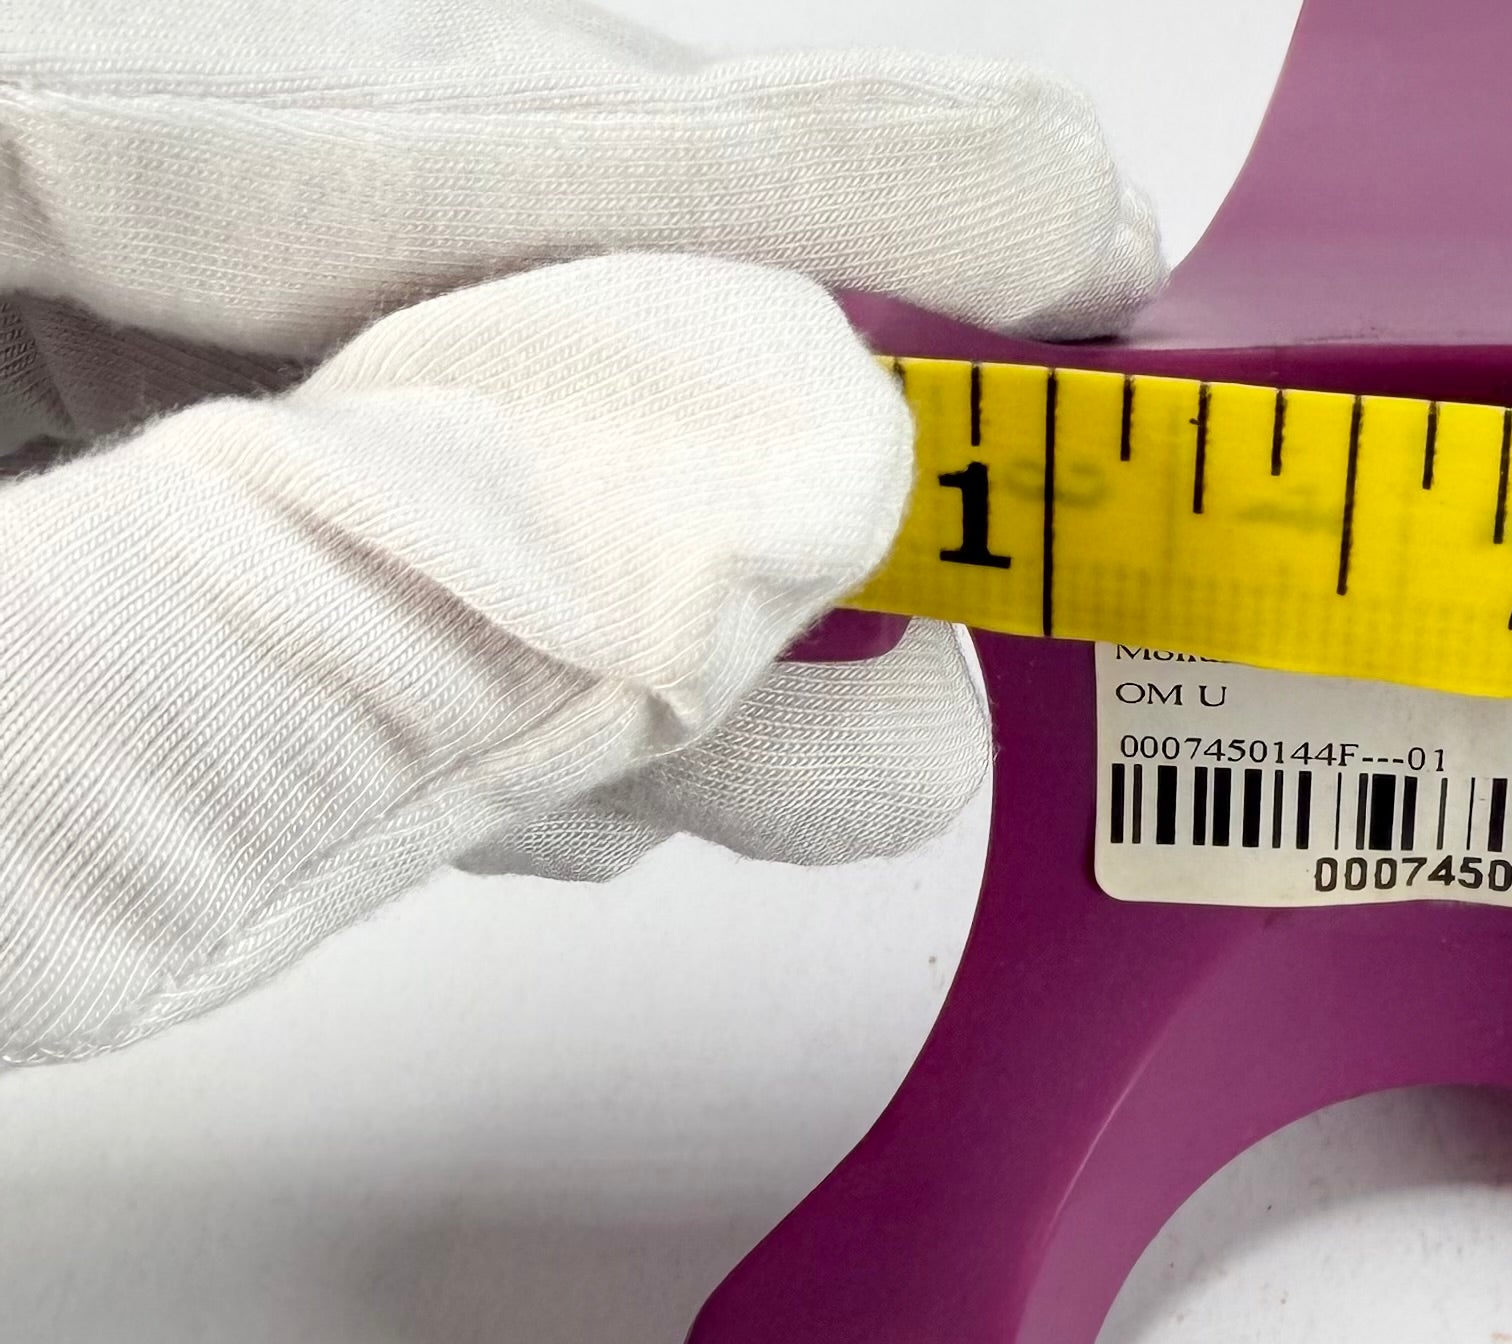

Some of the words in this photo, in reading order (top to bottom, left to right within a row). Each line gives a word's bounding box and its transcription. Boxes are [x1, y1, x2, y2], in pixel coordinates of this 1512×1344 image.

[938, 461, 1012, 569] 1
[1115, 682, 1183, 706] OM
[1198, 684, 1228, 707] U
